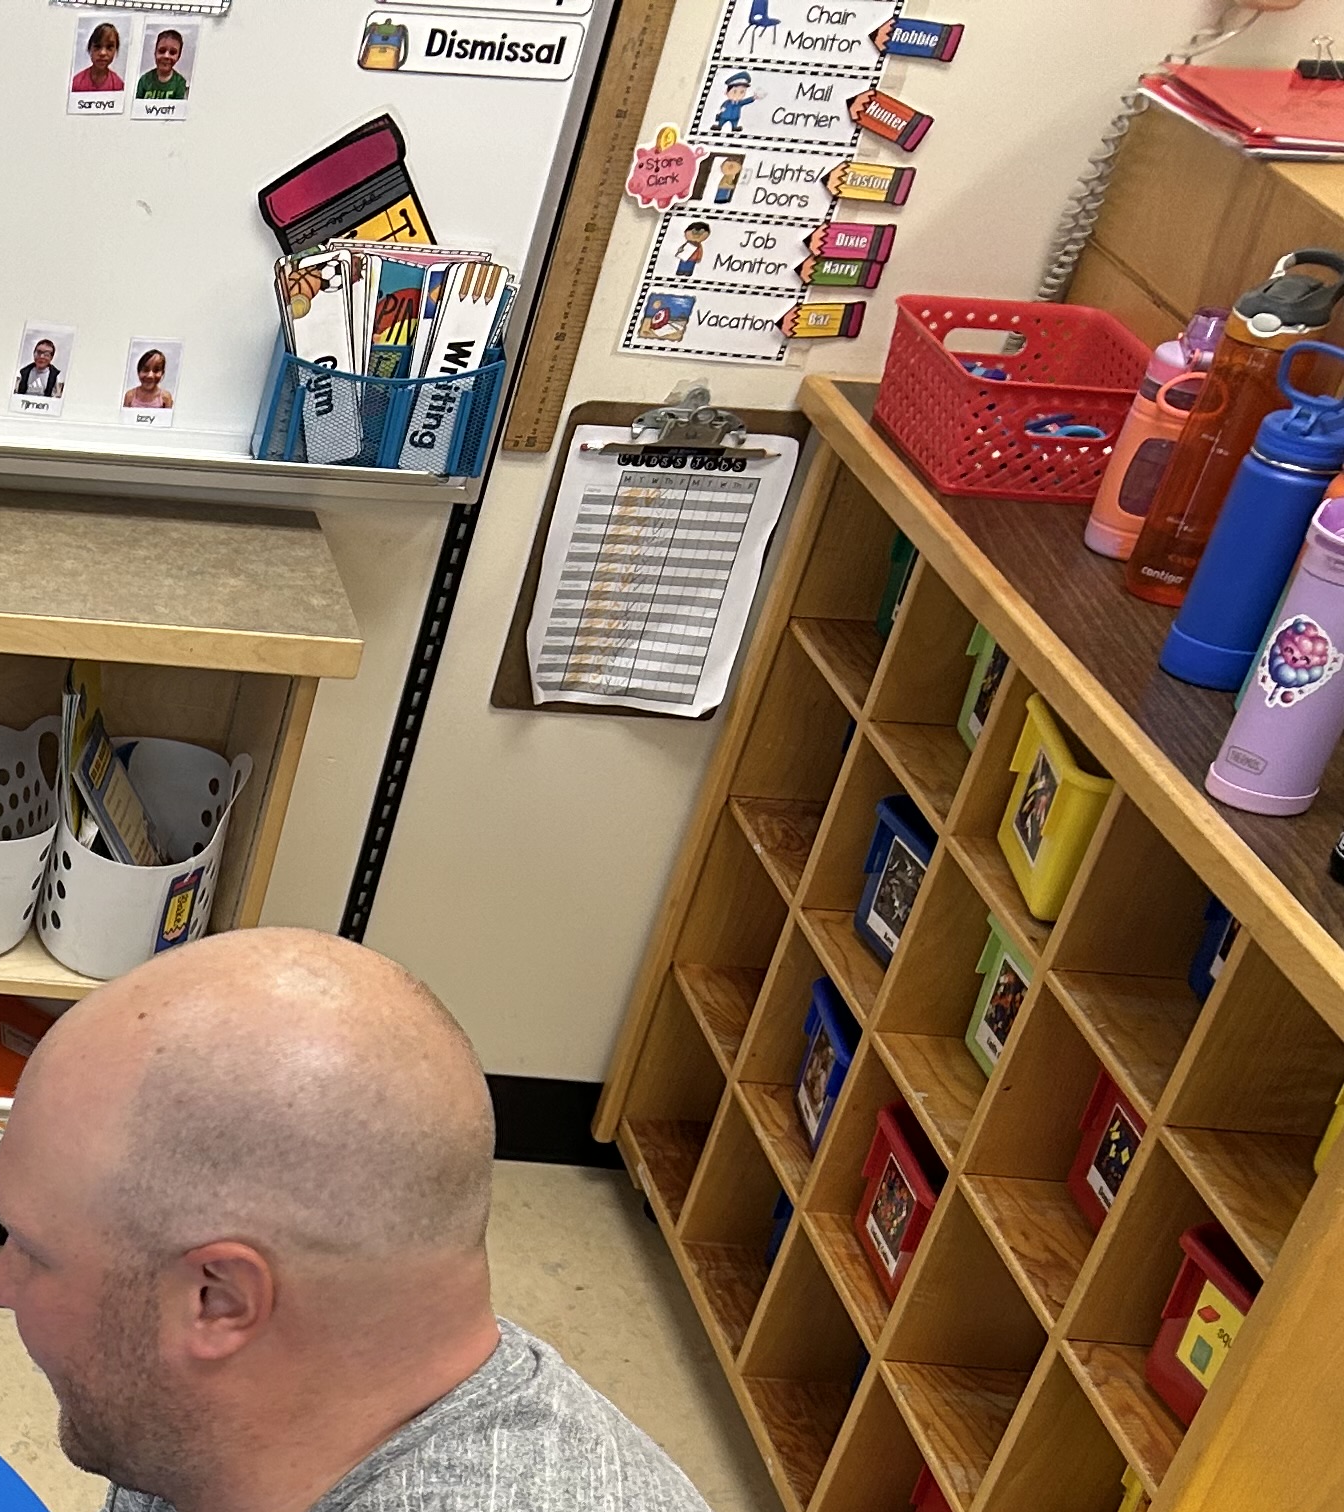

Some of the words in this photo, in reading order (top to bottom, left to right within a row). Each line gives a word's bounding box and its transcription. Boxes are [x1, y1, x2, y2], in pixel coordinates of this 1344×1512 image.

[806, 5, 856, 26] Chair
[425, 27, 567, 65] Dismissal
[784, 32, 861, 53] Monitor
[891, 27, 939, 48] Robbie
[796, 83, 833, 102] Mail
[145, 105, 175, 115] Wyatt
[772, 107, 840, 128] Carrier
[866, 101, 907, 131] Hunter
[646, 155, 684, 170] Store
[646, 173, 679, 188] Clerk
[756, 164, 825, 185] Lights/
[846, 172, 890, 190] Easton
[752, 187, 809, 208] Doors
[740, 230, 776, 250] Job
[835, 233, 868, 250] Dixie
[713, 254, 787, 276] Monitor
[823, 261, 857, 277] Harry
[697, 309, 775, 331] Vacation
[409, 340, 476, 449] Writing
[1141, 564, 1186, 585] contigo
